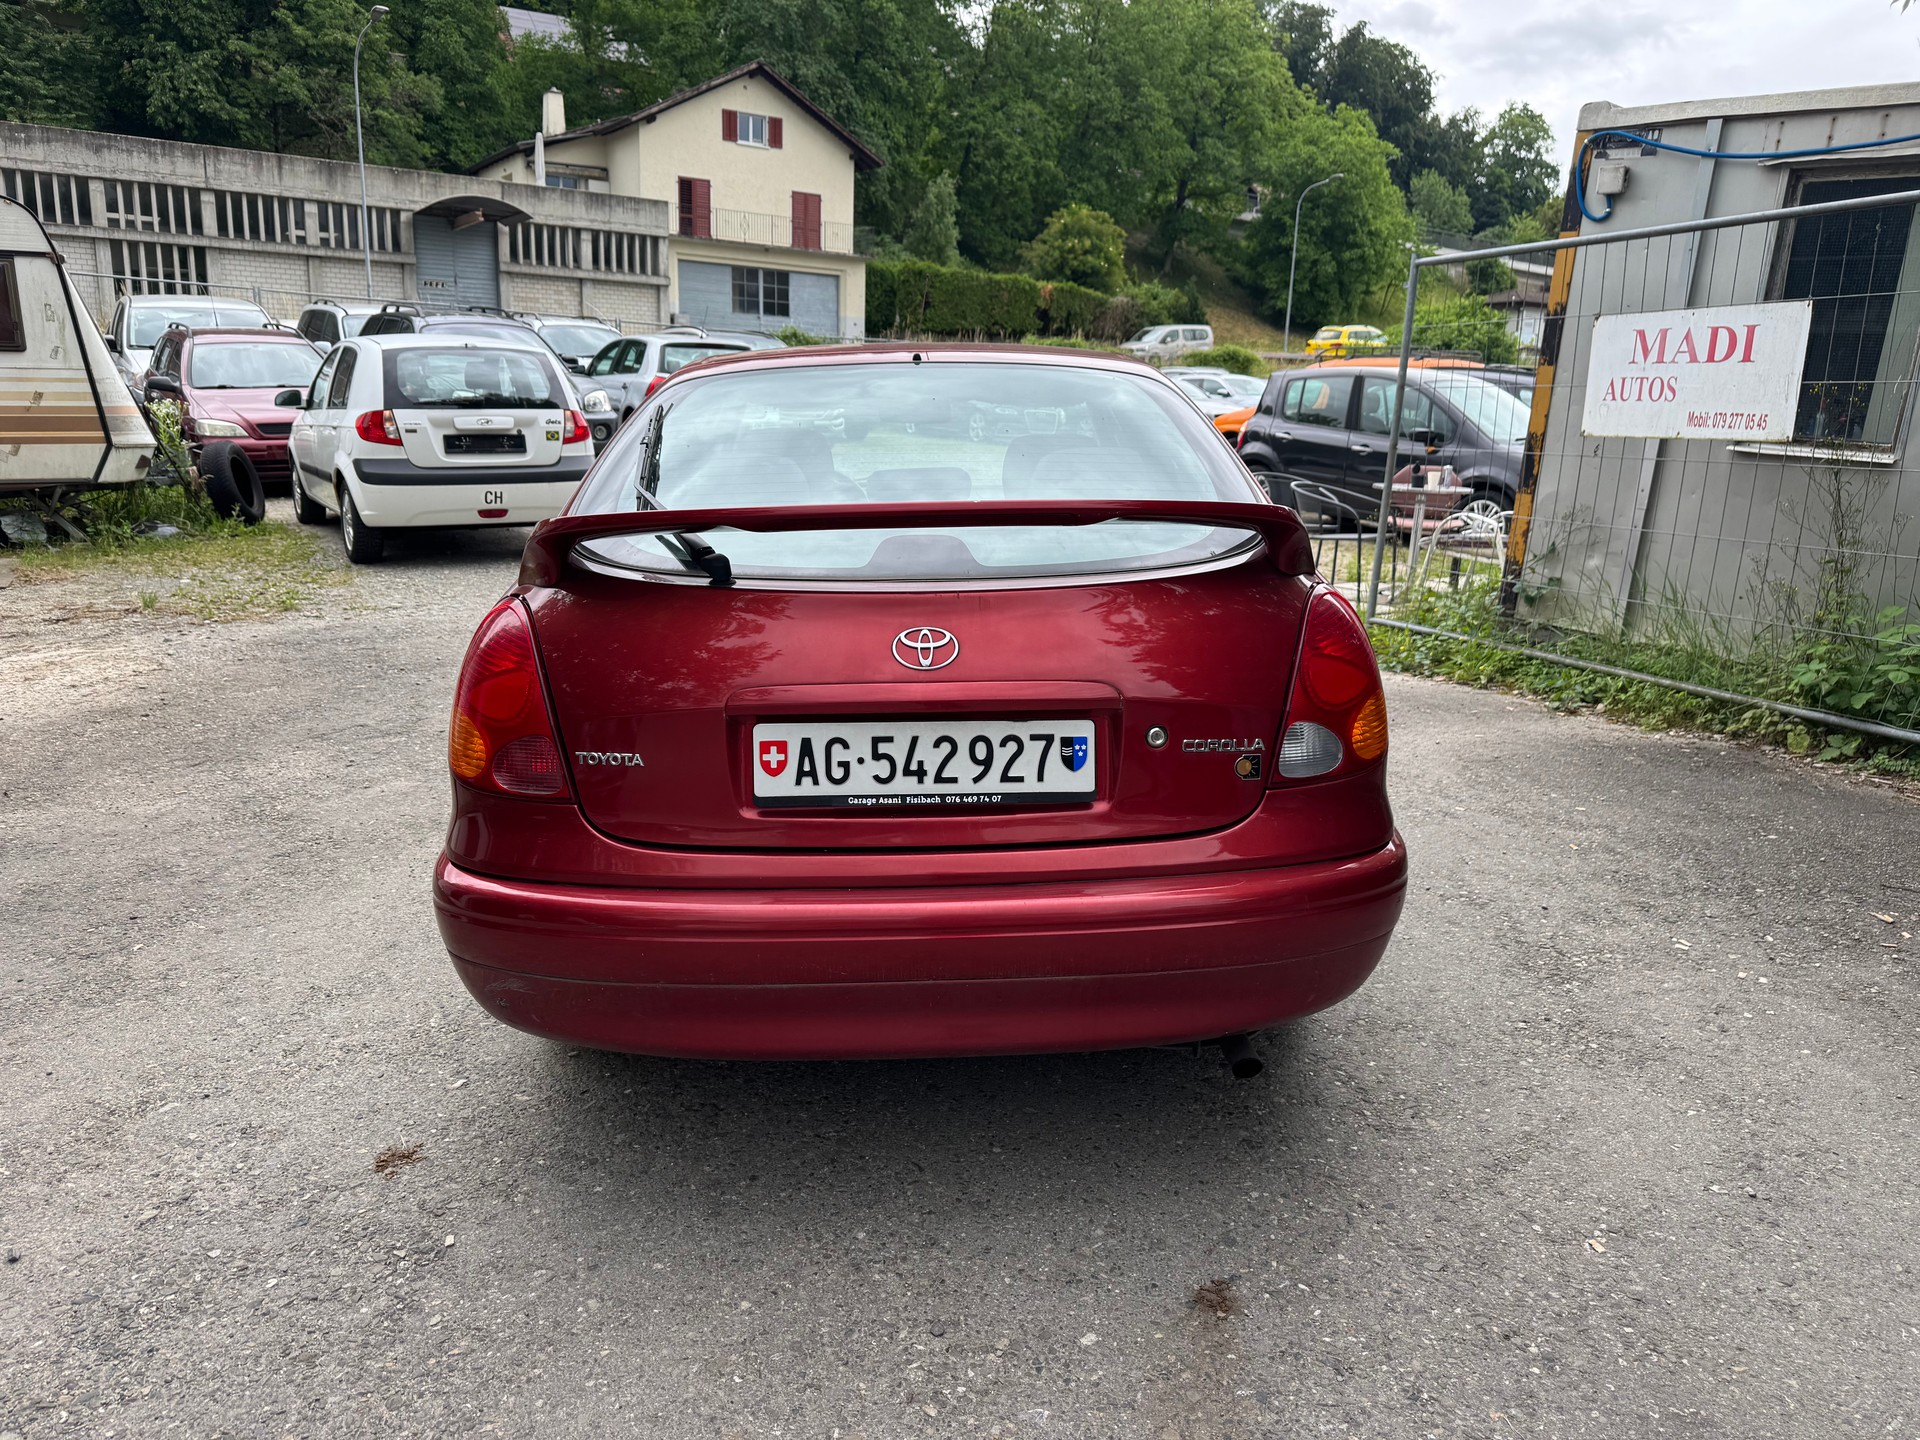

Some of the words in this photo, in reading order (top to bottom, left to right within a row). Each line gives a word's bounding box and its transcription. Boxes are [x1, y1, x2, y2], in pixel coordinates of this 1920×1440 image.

[1628, 323, 1761, 365] MADI
[1602, 376, 1678, 402] AUTOS
[1686, 411, 1711, 428] Mobil:
[1712, 411, 1728, 429] 079
[1728, 412, 1744, 430] 277
[1744, 413, 1756, 430] 05
[1756, 413, 1769, 431] 45
[484, 490, 503, 505] CH
[1182, 738, 1266, 752] COROLLA
[575, 751, 645, 767] TOYOTA
[848, 796, 876, 806] Garage
[878, 796, 902, 804] Asani
[906, 795, 941, 804] Fisibach
[945, 795, 961, 803] 076
[962, 795, 977, 803] 469
[979, 795, 989, 803] 74
[991, 795, 1002, 803] 07
